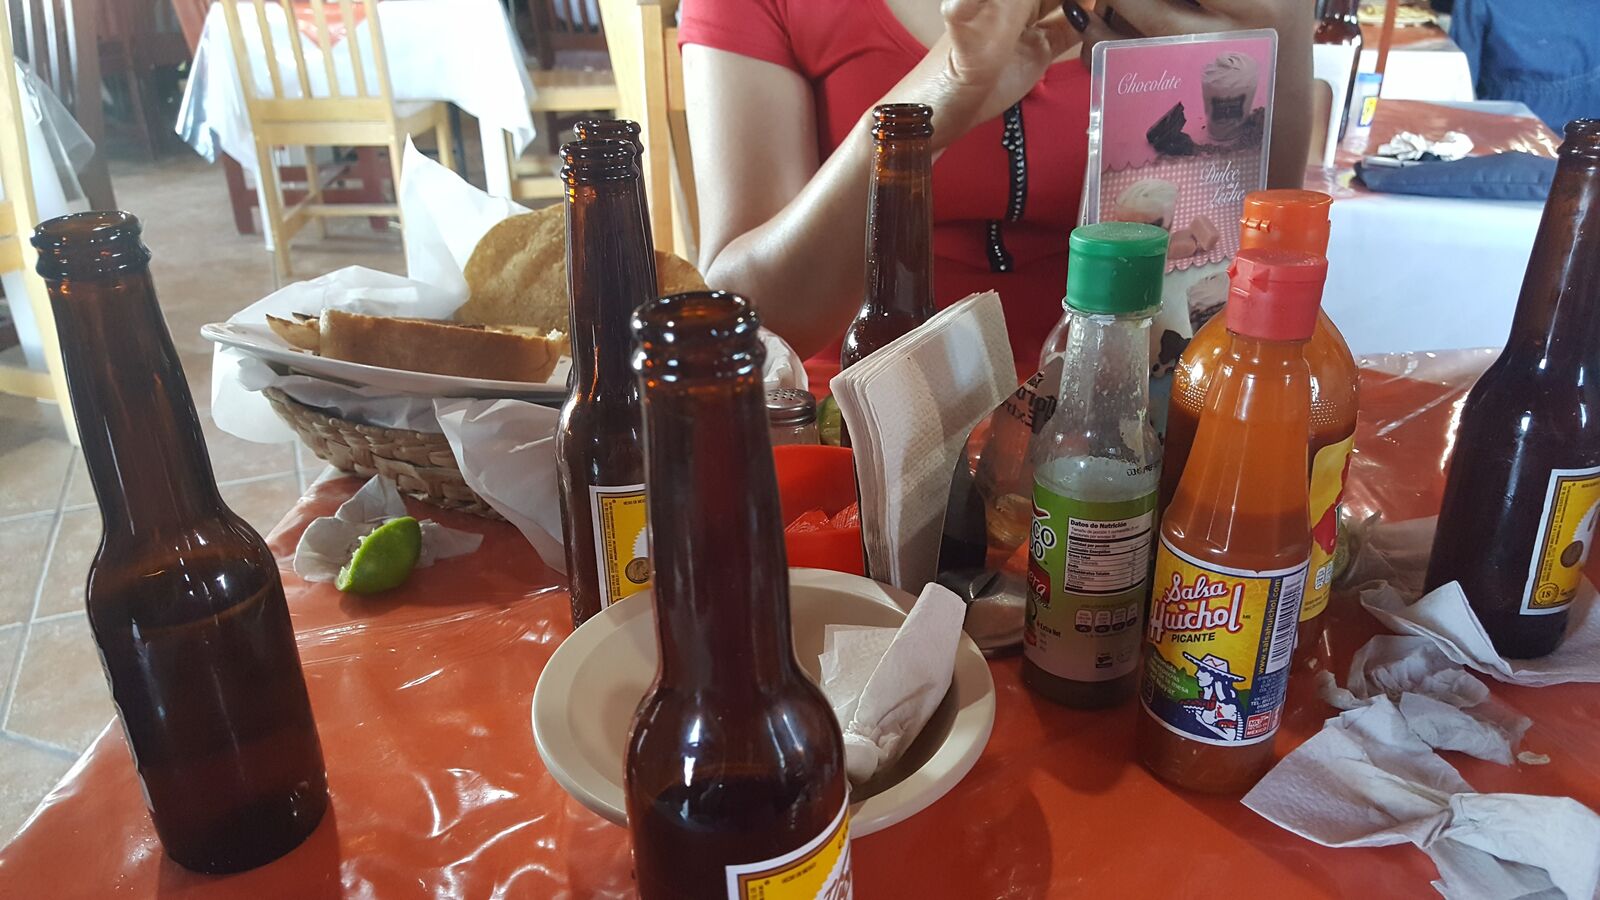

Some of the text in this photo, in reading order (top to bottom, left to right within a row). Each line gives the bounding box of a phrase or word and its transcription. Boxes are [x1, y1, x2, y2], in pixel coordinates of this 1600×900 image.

[1117, 70, 1182, 96] Chocolate
[1200, 161, 1240, 184] Dulce
[1070, 520, 1089, 528] Datos
[1099, 521, 1127, 529] Nutrición
[1165, 573, 1226, 603] Salsa
[1150, 585, 1243, 642] Huichol
[1258, 579, 1281, 674] www.salsahuichol.com
[1171, 632, 1216, 643] PICANTE
